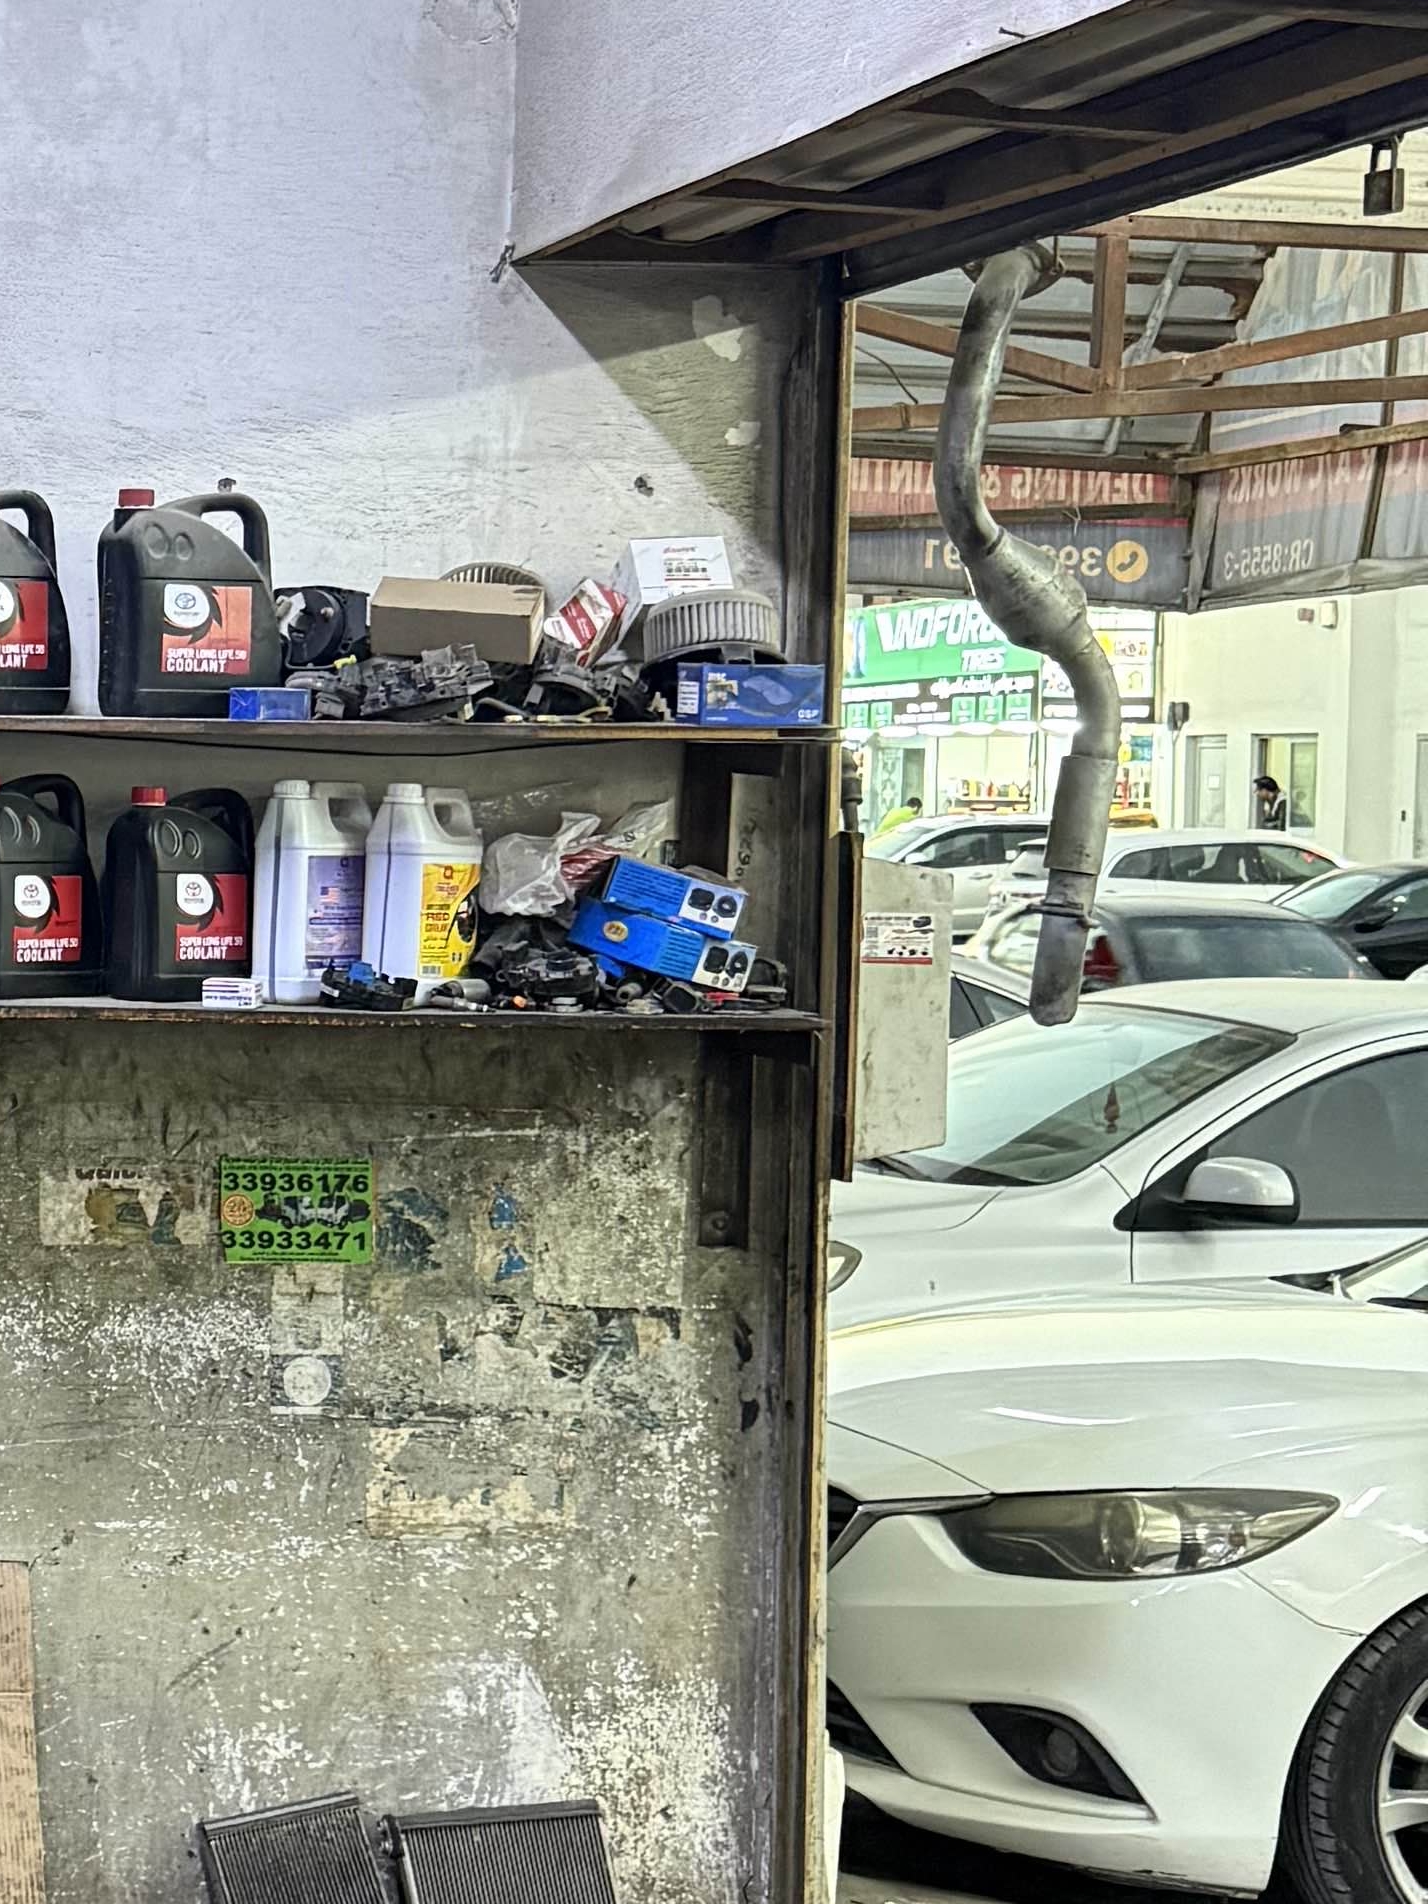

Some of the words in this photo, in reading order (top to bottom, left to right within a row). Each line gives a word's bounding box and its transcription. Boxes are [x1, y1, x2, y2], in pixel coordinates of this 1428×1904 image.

[166, 658, 227, 673] COOLANT
[16, 948, 63, 963] COOLANT
[179, 947, 227, 960] COOLANT
[223, 1172, 369, 1193] 33936176
[222, 1230, 366, 1250] 33933471
